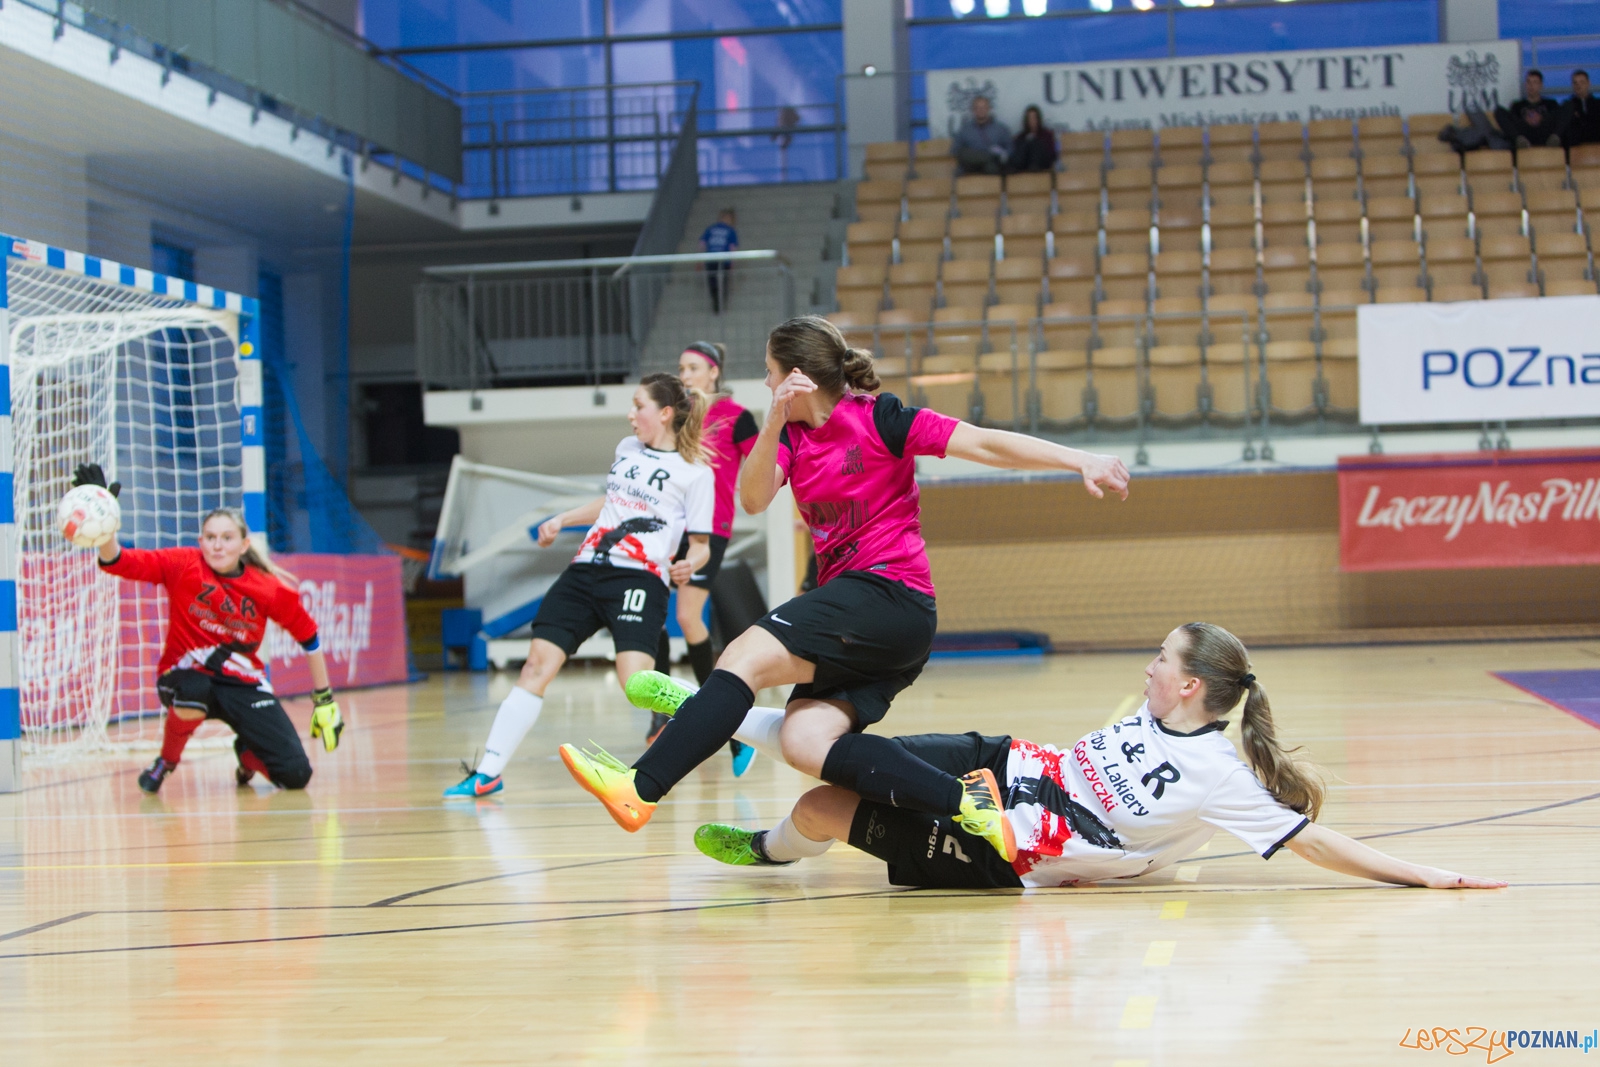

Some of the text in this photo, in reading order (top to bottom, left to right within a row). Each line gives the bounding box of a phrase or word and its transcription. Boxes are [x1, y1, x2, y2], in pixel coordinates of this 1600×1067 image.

[1043, 53, 1404, 104] UNIWERSYTET
[627, 485, 660, 505] Lakiery
[647, 467, 671, 493] R
[195, 582, 217, 606] Z
[241, 595, 257, 618] R
[622, 588, 647, 612] 10
[1074, 740, 1119, 813] Gorzyczki
[1103, 763, 1150, 816] Lakiery
[1121, 741, 1146, 764] &
[1141, 761, 1181, 800] R
[926, 819, 940, 859] regio
[942, 834, 973, 864] 7
